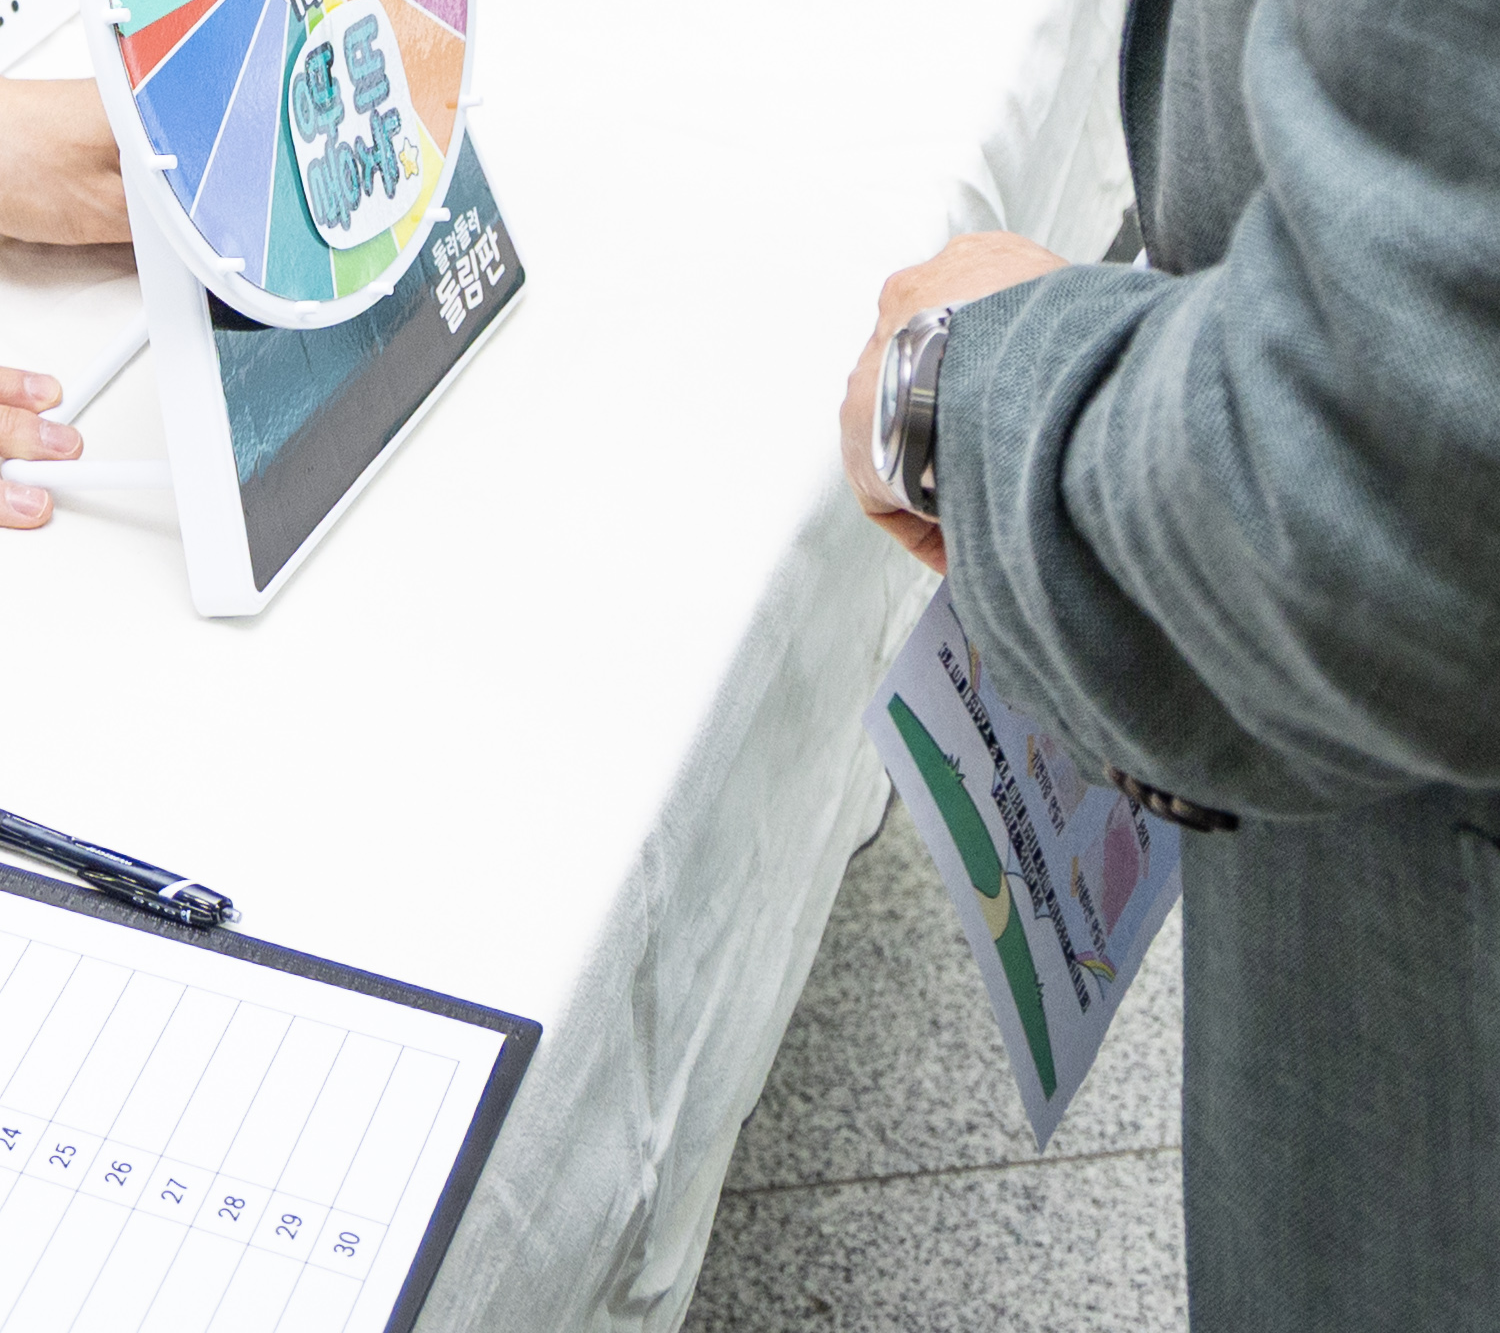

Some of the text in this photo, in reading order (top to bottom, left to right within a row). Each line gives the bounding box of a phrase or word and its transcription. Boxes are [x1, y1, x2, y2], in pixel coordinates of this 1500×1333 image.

[435, 225, 506, 335] 돌림판
[48, 1143, 77, 1169] 25
[104, 1160, 133, 1187] 26
[160, 1177, 188, 1205] 27
[217, 1195, 246, 1222] 28
[275, 1213, 303, 1241] 29
[333, 1231, 361, 1258] 30
